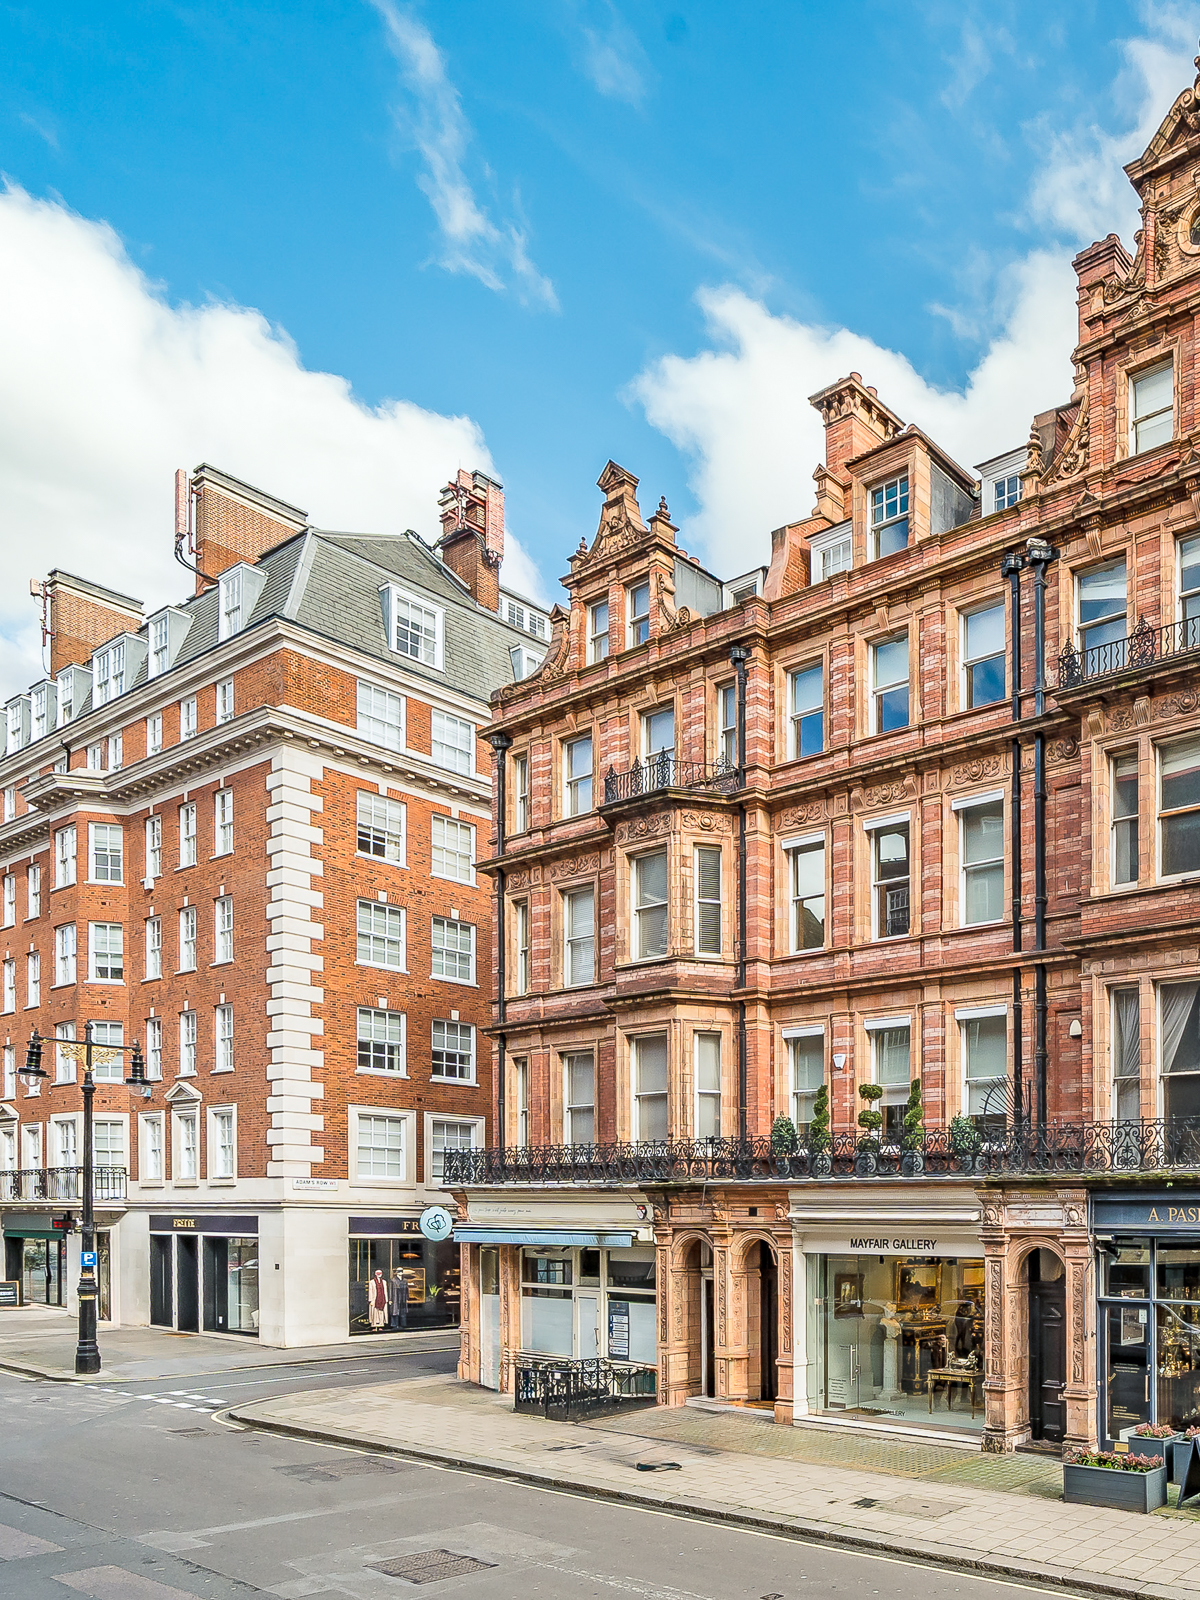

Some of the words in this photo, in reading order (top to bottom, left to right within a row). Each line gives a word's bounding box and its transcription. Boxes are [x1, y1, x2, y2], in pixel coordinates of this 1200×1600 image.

[1148, 1207, 1164, 1222] A.
[850, 1238, 890, 1249] MAYFAIR
[892, 1239, 937, 1250] GALLERY
[84, 1253, 94, 1262] P
